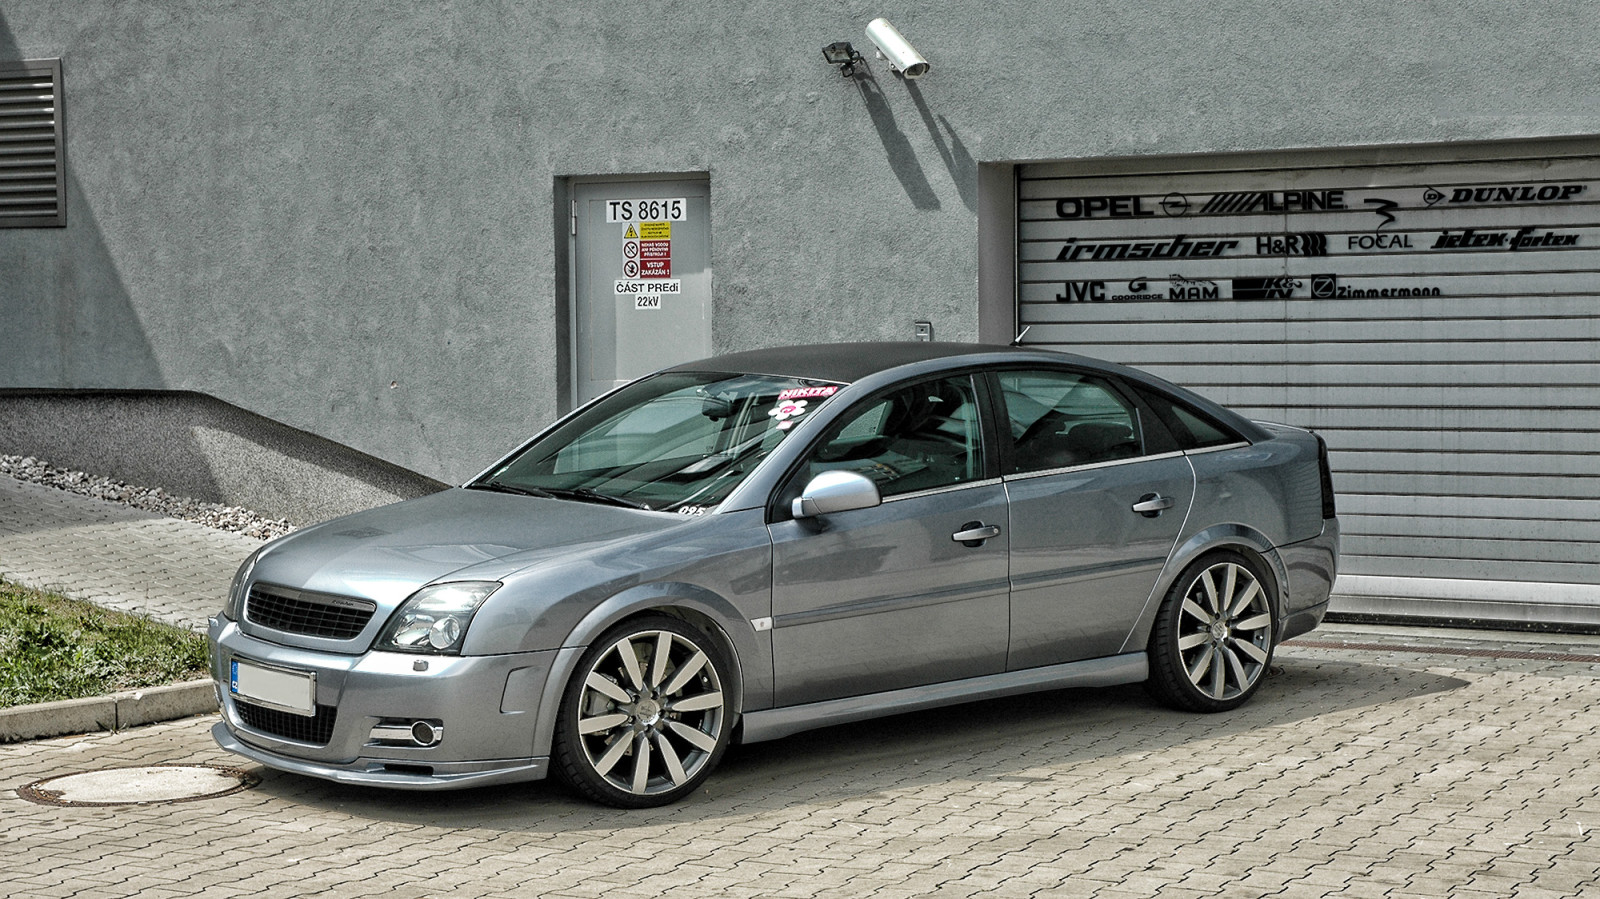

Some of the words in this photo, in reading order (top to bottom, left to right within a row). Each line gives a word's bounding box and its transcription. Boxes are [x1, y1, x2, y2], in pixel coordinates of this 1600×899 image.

[1448, 185, 1582, 203] DUNLOP
[609, 201, 633, 220] TS
[638, 200, 682, 219] 8615
[1056, 197, 1154, 217] OPEL
[1056, 235, 1239, 260] irmscher
[1256, 236, 1299, 254] H&R
[1348, 234, 1413, 249] FOCAL
[616, 282, 644, 293] ČÁST
[647, 283, 679, 292] PREdi
[1056, 281, 1106, 302] JVC
[1169, 287, 1219, 300] MAM
[1337, 286, 1441, 299] Zimmermann
[637, 297, 659, 307] 22kV
[779, 386, 836, 398] NIKITA
